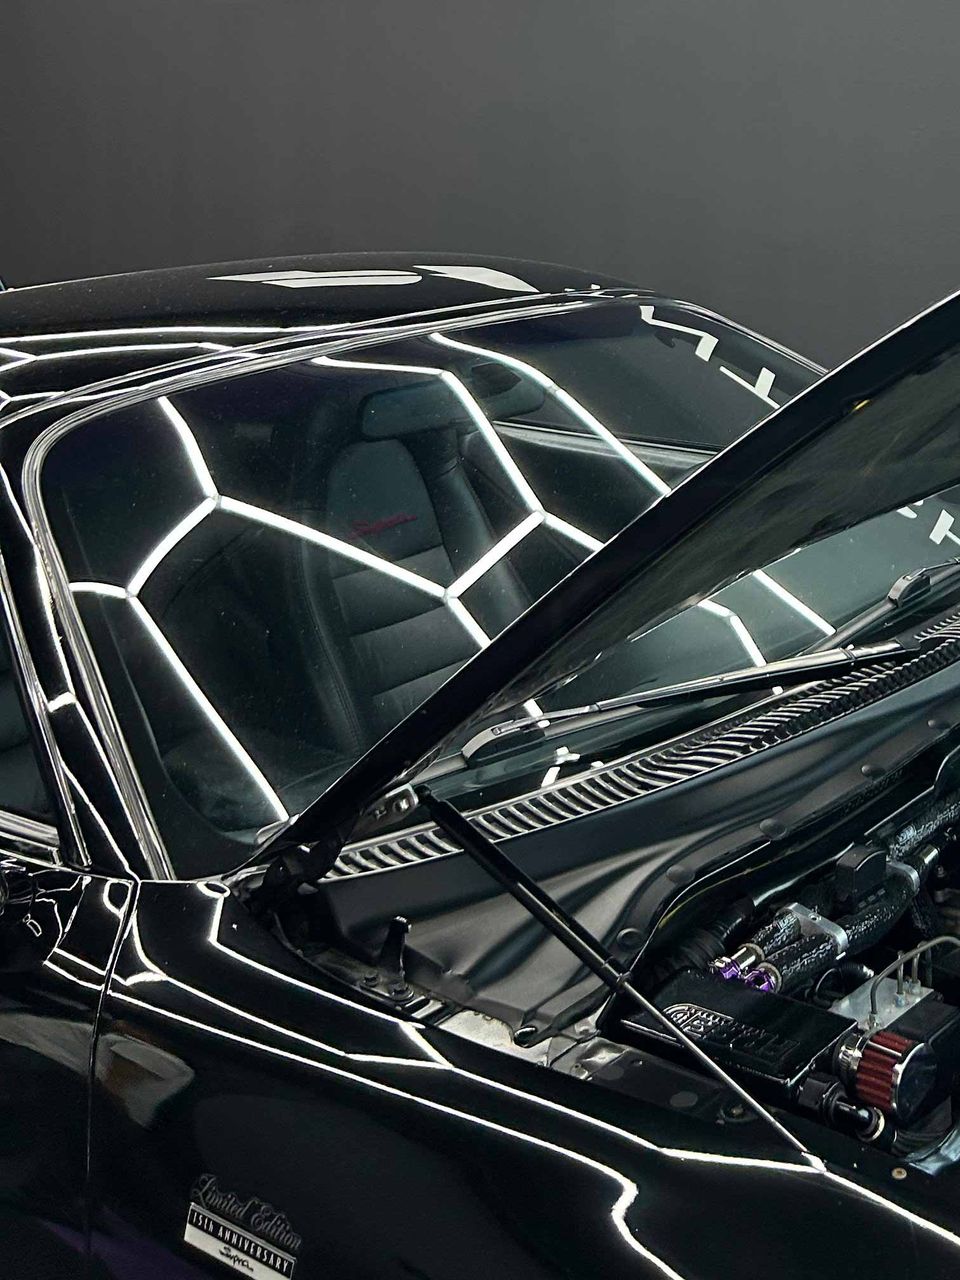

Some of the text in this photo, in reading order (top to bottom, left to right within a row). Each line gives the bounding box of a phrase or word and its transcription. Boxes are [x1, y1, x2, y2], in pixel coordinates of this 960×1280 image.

[191, 1173, 302, 1250] Limited Edition
[192, 1211, 290, 1273] 15th ANNIVERSARY
[218, 1245, 254, 1273] Supra
